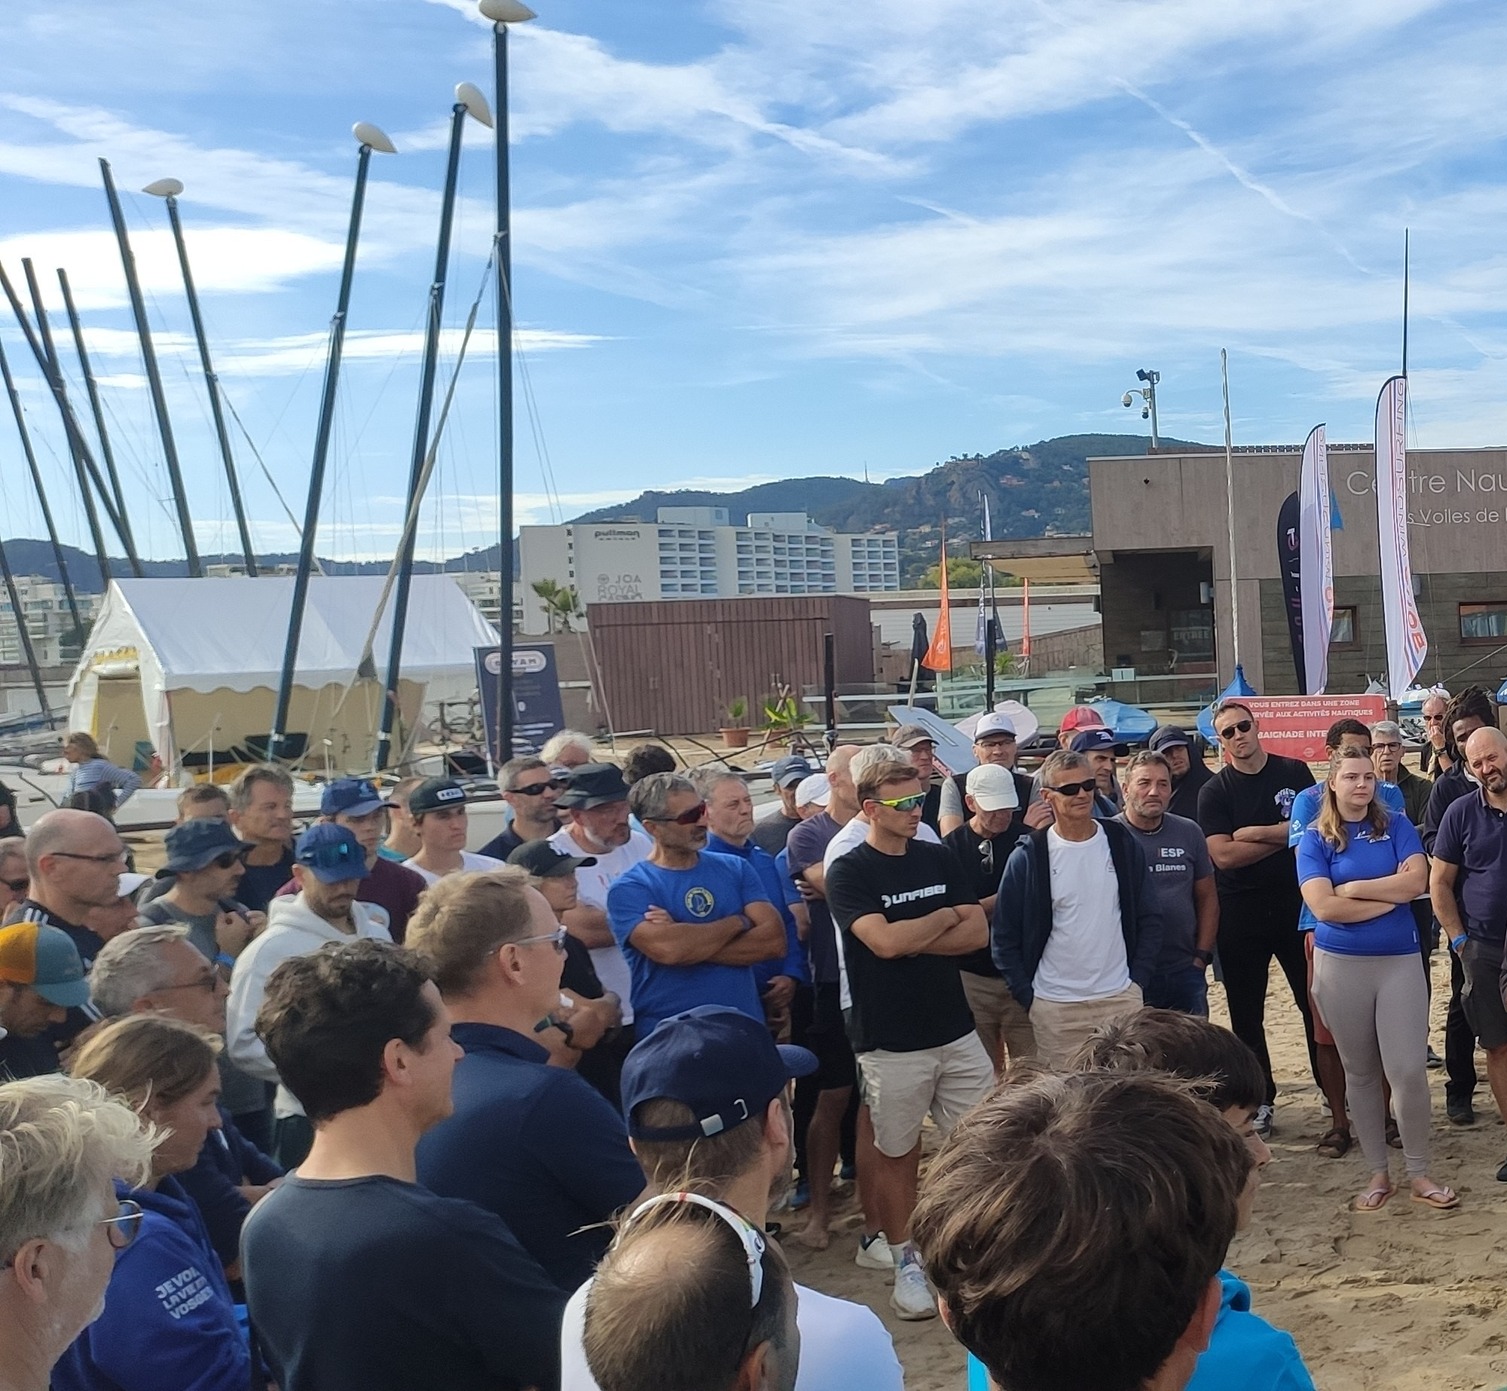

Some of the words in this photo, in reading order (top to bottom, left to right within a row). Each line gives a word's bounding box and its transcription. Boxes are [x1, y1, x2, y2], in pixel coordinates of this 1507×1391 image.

[1346, 470, 1446, 495] Ctre
[1420, 509, 1471, 524] Voiles
[1476, 507, 1499, 523] de
[594, 529, 641, 538] pullman
[1293, 709, 1330, 717] ACTIVITÉS
[1331, 709, 1373, 717] NAUTIQUES
[1306, 730, 1328, 738] INTE
[1161, 847, 1185, 858] ESP
[1155, 863, 1186, 872] Blanes
